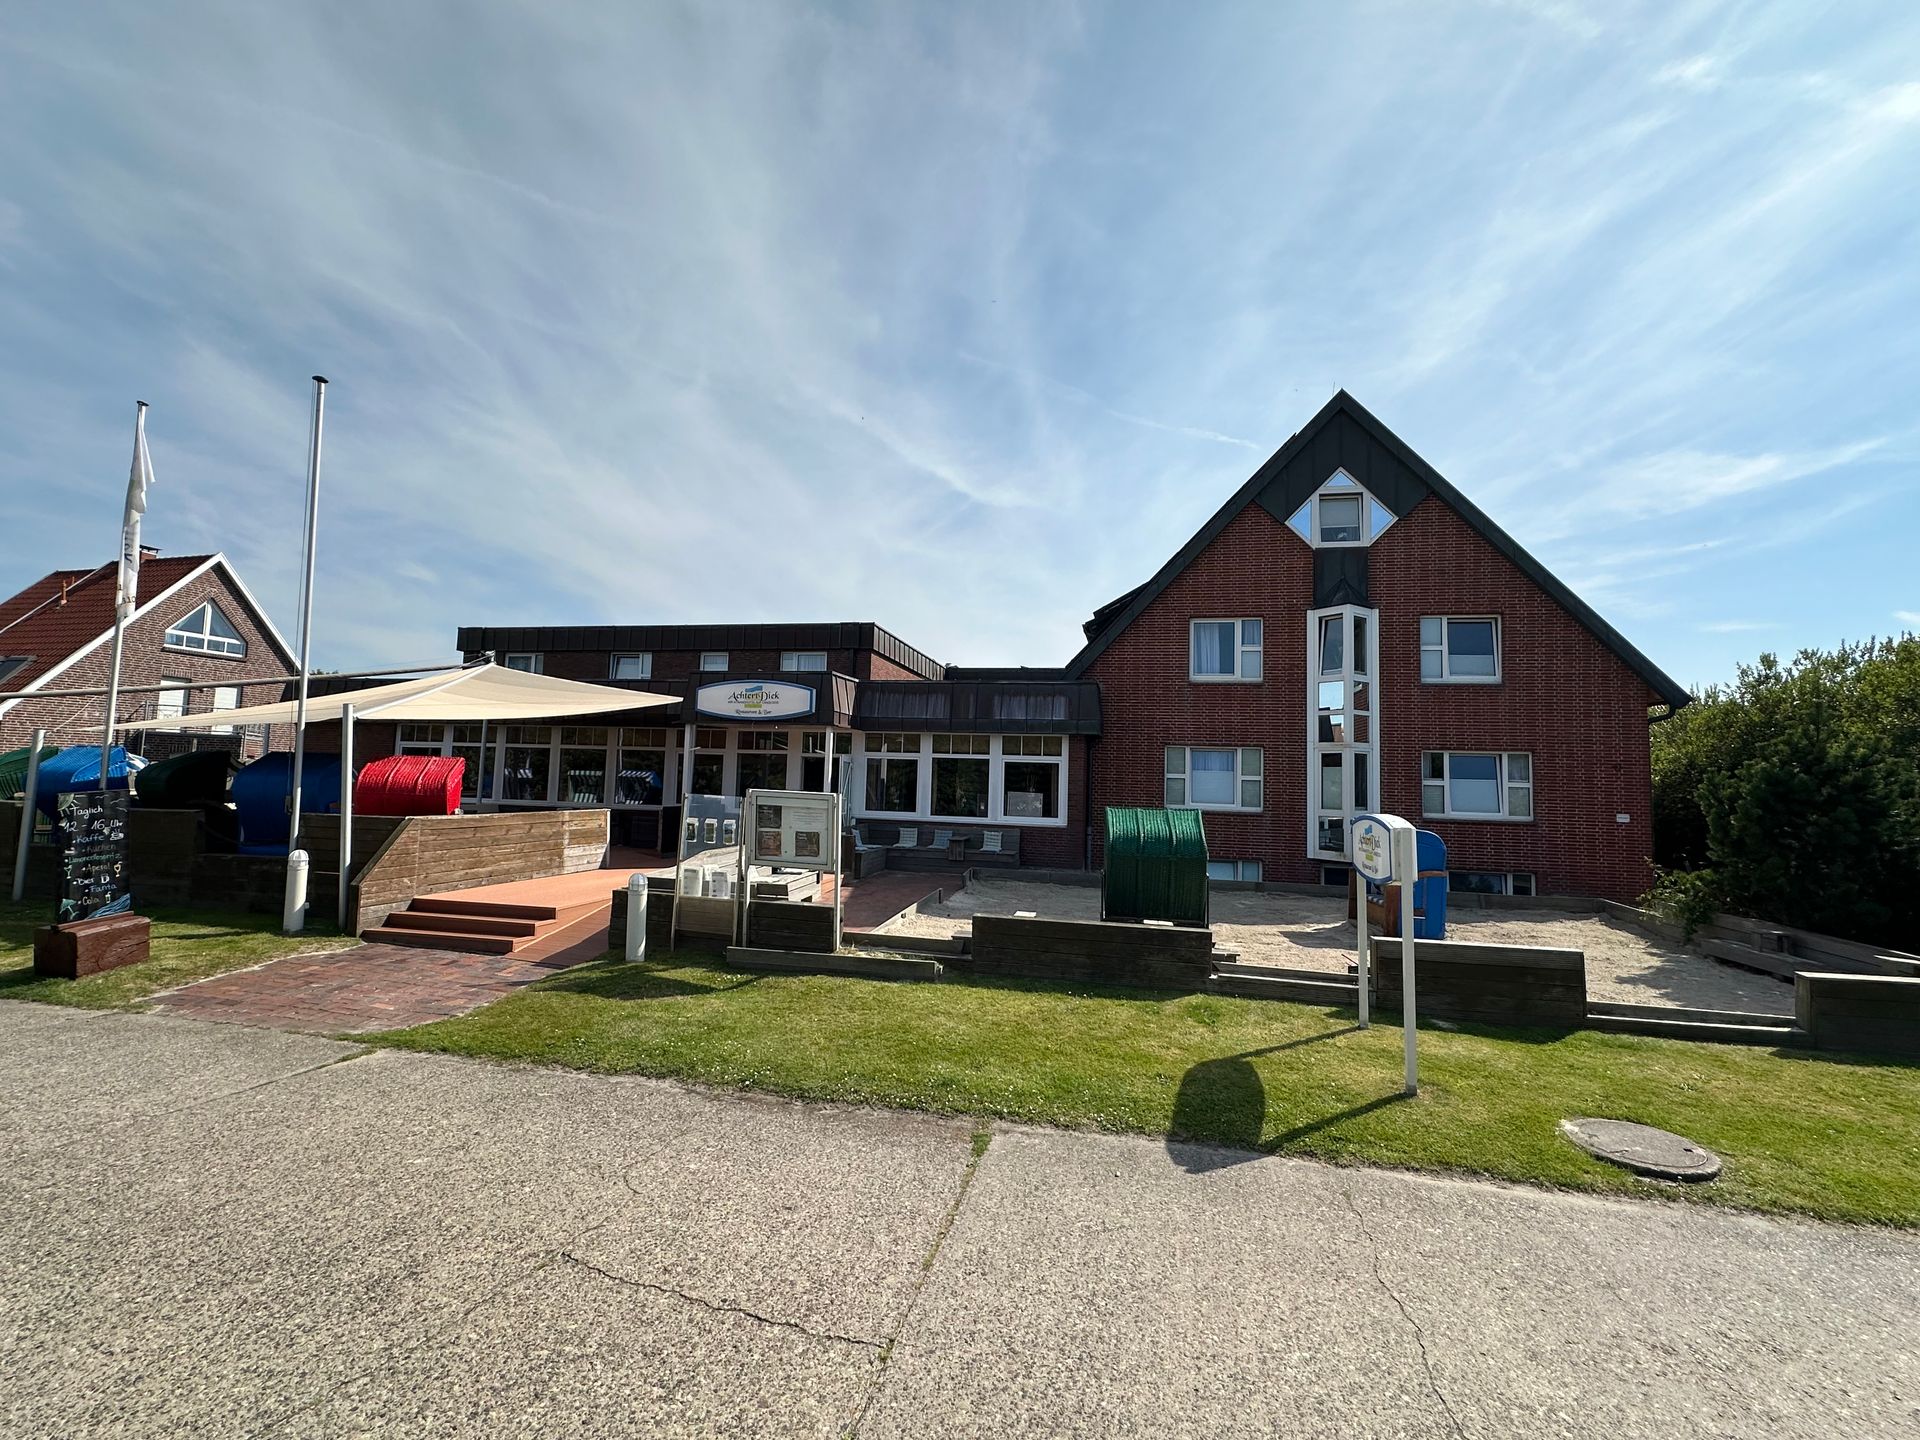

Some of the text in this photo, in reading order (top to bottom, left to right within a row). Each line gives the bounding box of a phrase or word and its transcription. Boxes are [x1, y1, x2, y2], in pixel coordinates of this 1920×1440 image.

[64, 821, 79, 833] 12
[91, 818, 106, 830] 16
[110, 819, 123, 828] Uhr
[89, 884, 117, 893] Fanta
[82, 896, 100, 906] Cola
